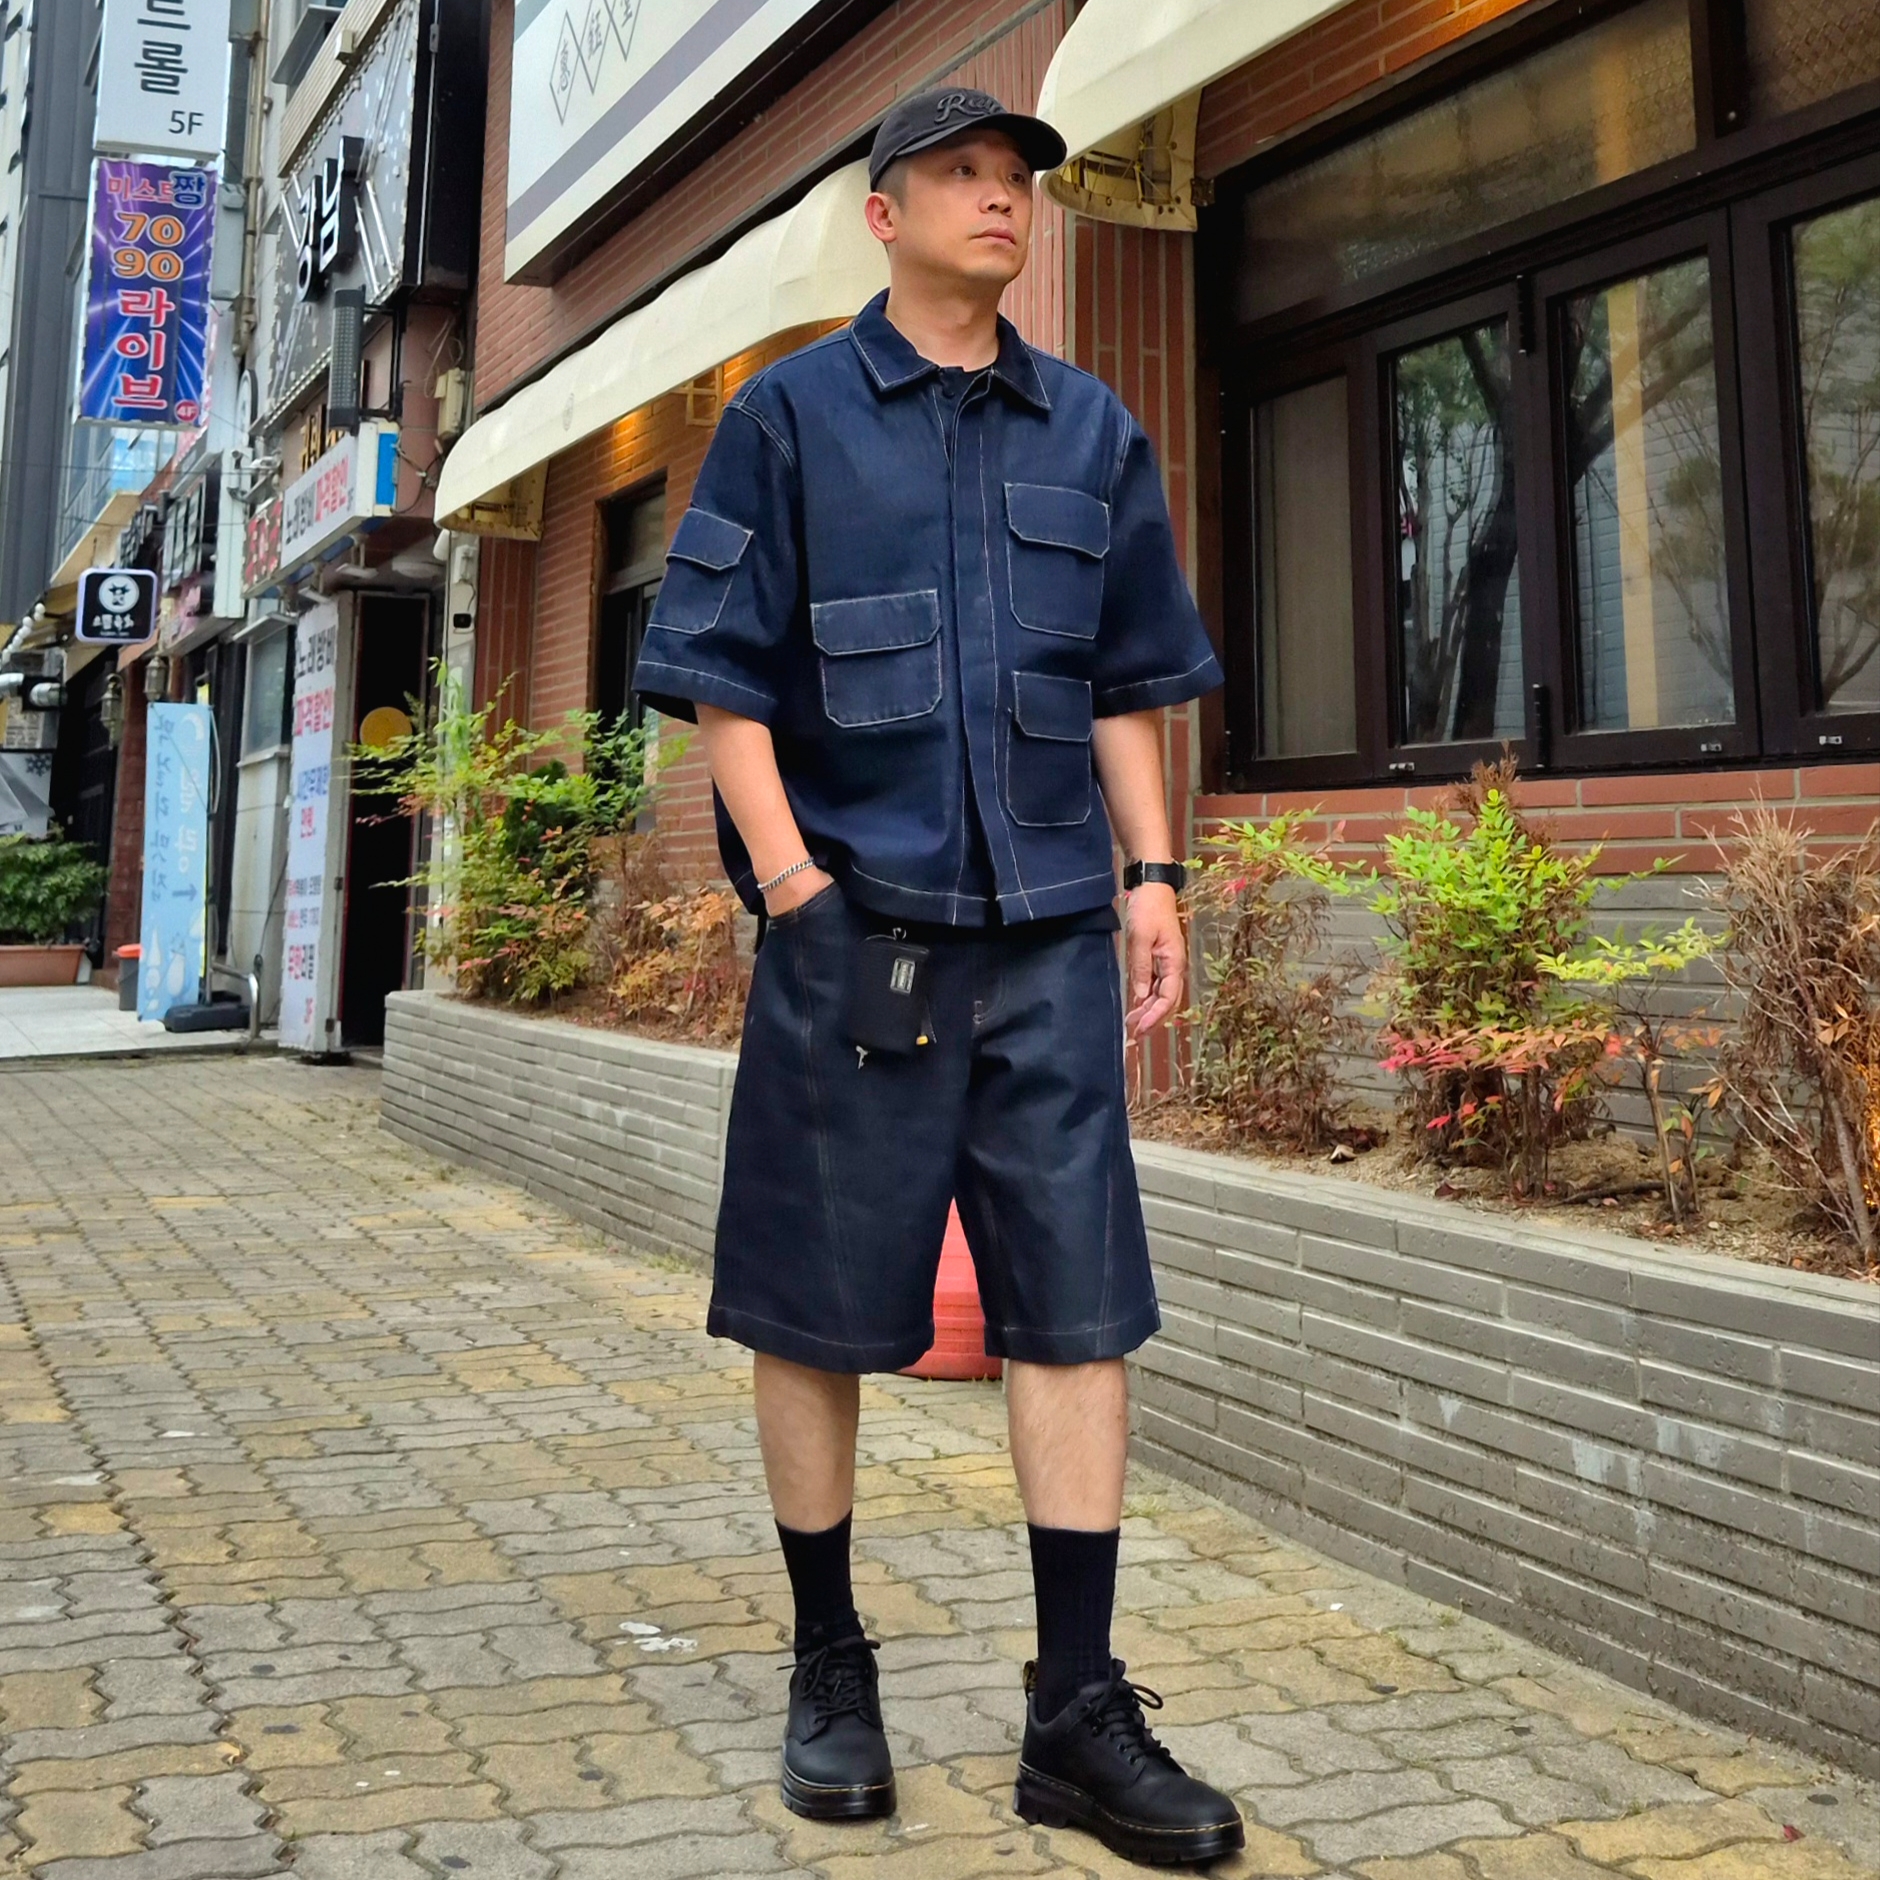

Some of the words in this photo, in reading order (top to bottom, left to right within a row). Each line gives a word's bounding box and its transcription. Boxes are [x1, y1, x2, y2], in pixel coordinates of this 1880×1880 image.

[168, 110, 204, 135] 5F
[116, 212, 185, 247] 70
[296, 136, 352, 302] 강남
[113, 248, 184, 282] 90
[112, 287, 176, 410] 라이브
[176, 405, 197, 418] 4F
